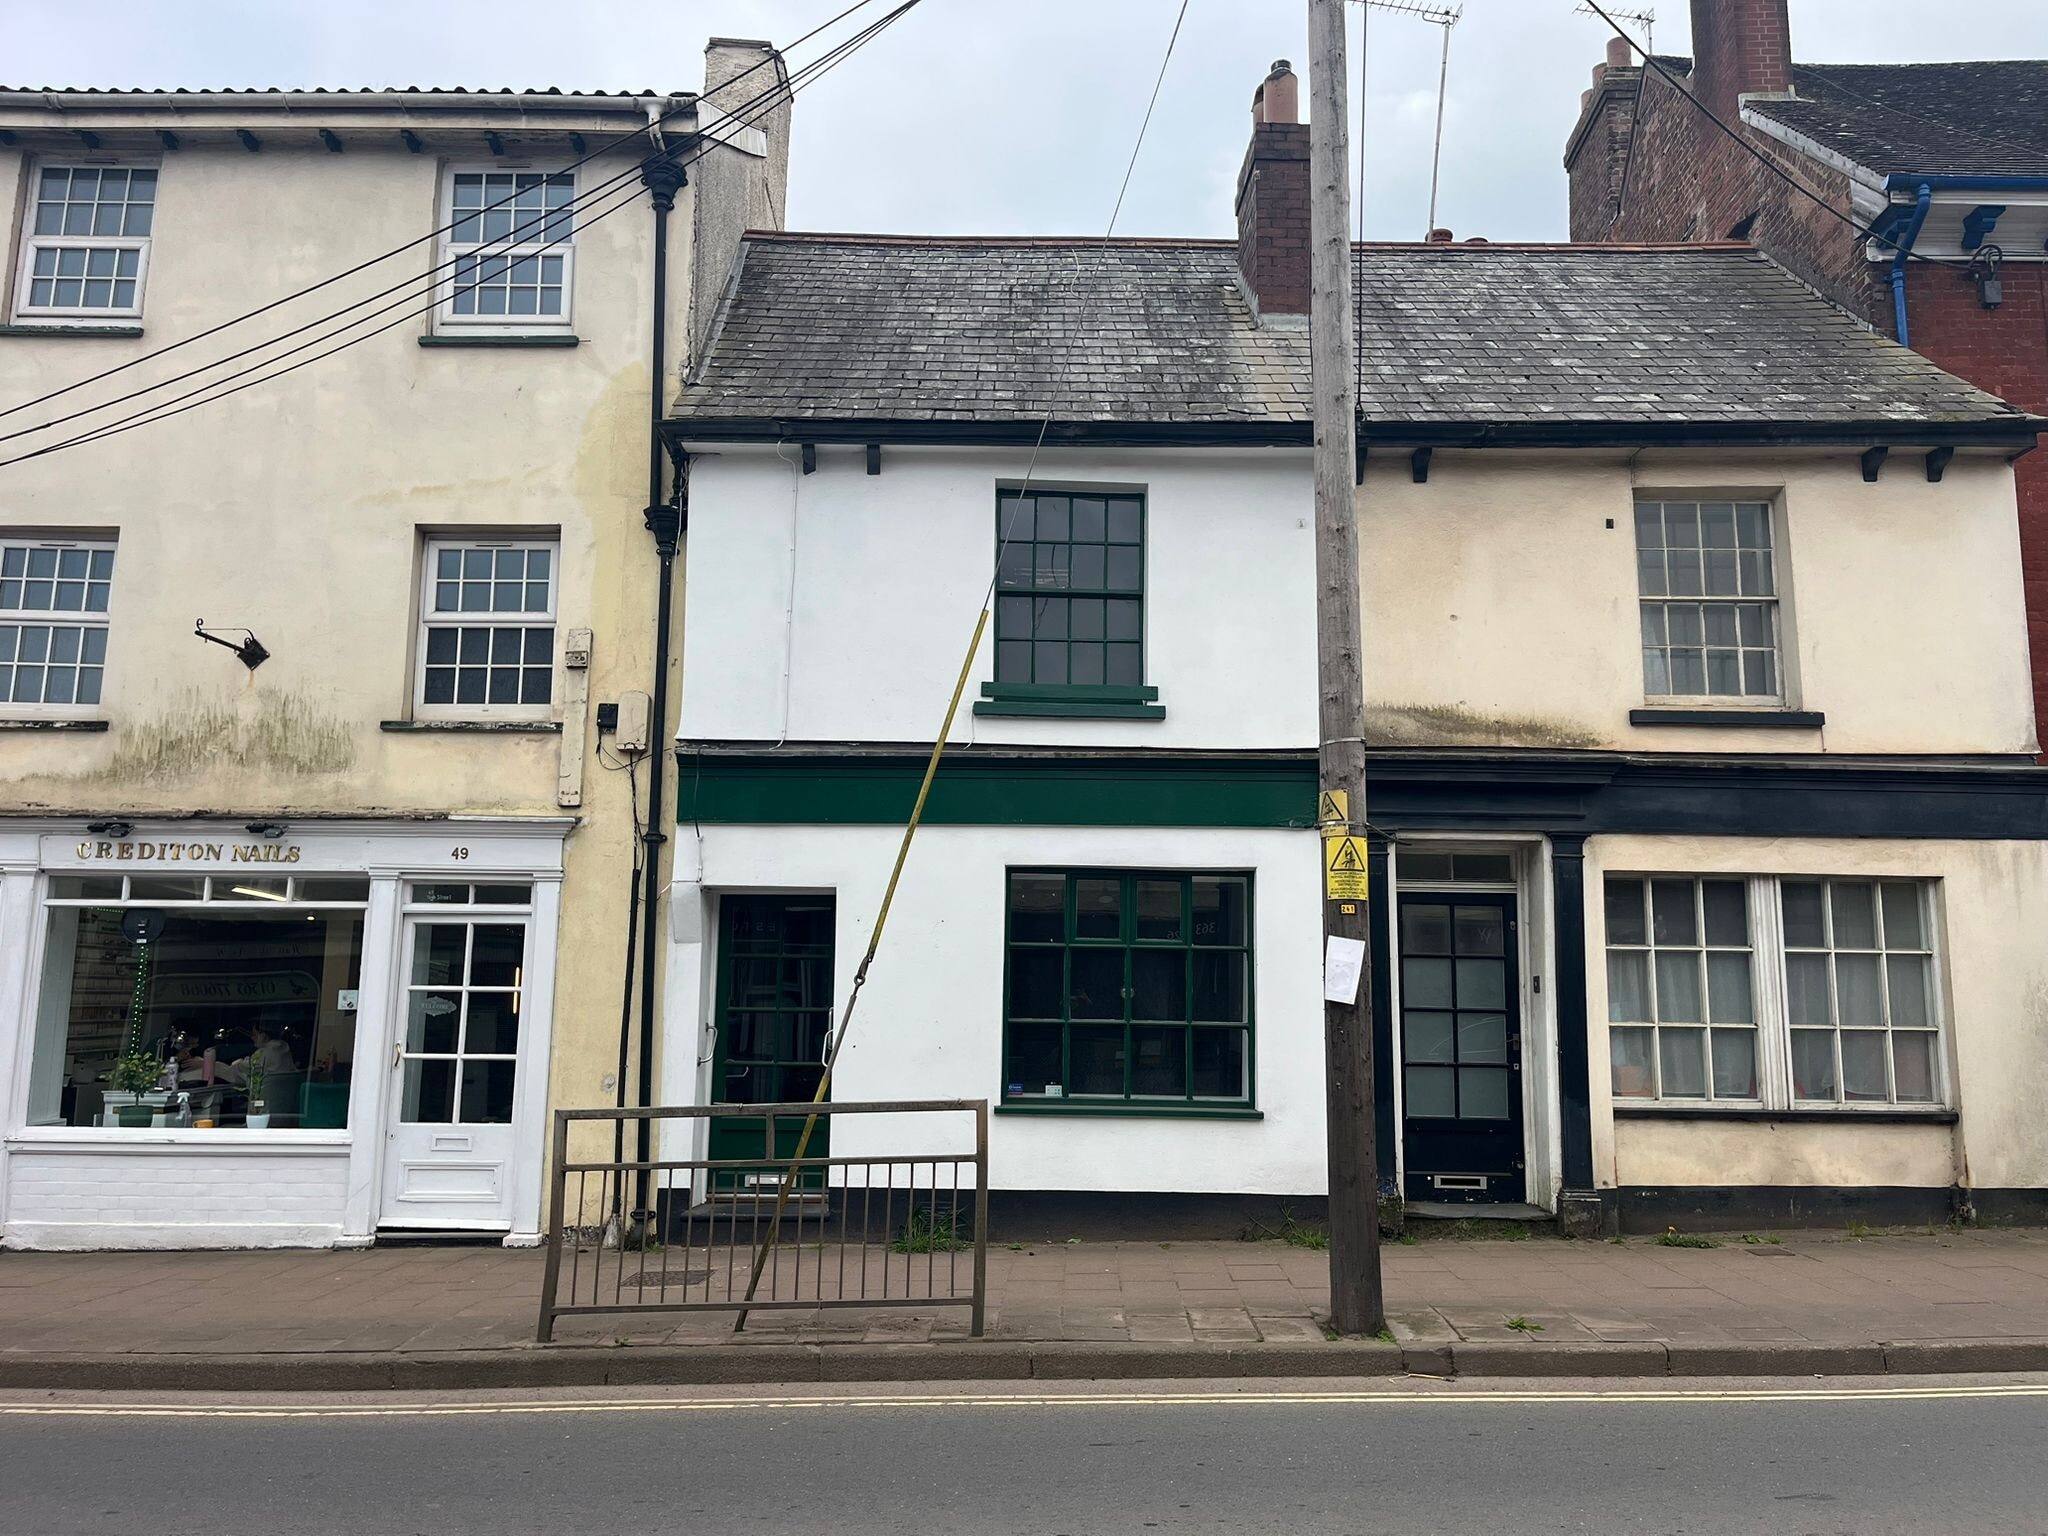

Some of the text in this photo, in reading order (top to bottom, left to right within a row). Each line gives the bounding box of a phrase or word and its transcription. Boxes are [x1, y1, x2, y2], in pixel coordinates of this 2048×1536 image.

[76, 841, 300, 863] CREDITON NAILS
[451, 847, 469, 860] 49
